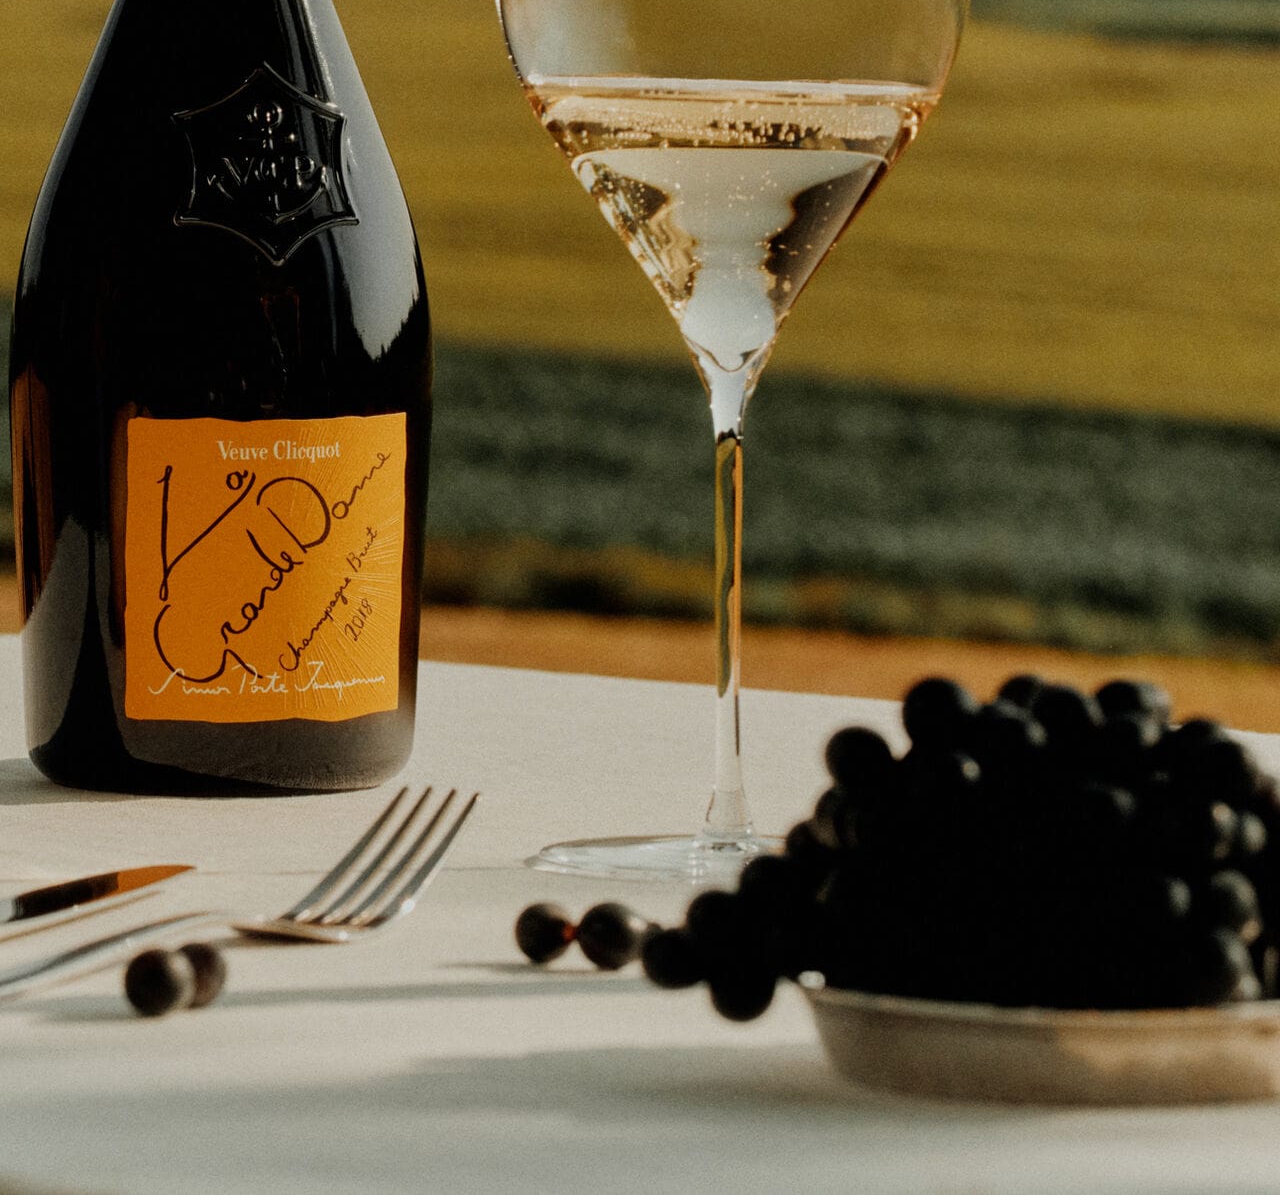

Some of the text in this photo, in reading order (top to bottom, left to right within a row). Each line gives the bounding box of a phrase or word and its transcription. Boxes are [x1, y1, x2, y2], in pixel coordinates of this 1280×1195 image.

[217, 440, 342, 464] Veuve Clicquot
[153, 452, 392, 684] La Grande Dame
[278, 526, 378, 672] Champagne Brut
[344, 598, 373, 642] 2018
[231, 663, 289, 695] Porte
